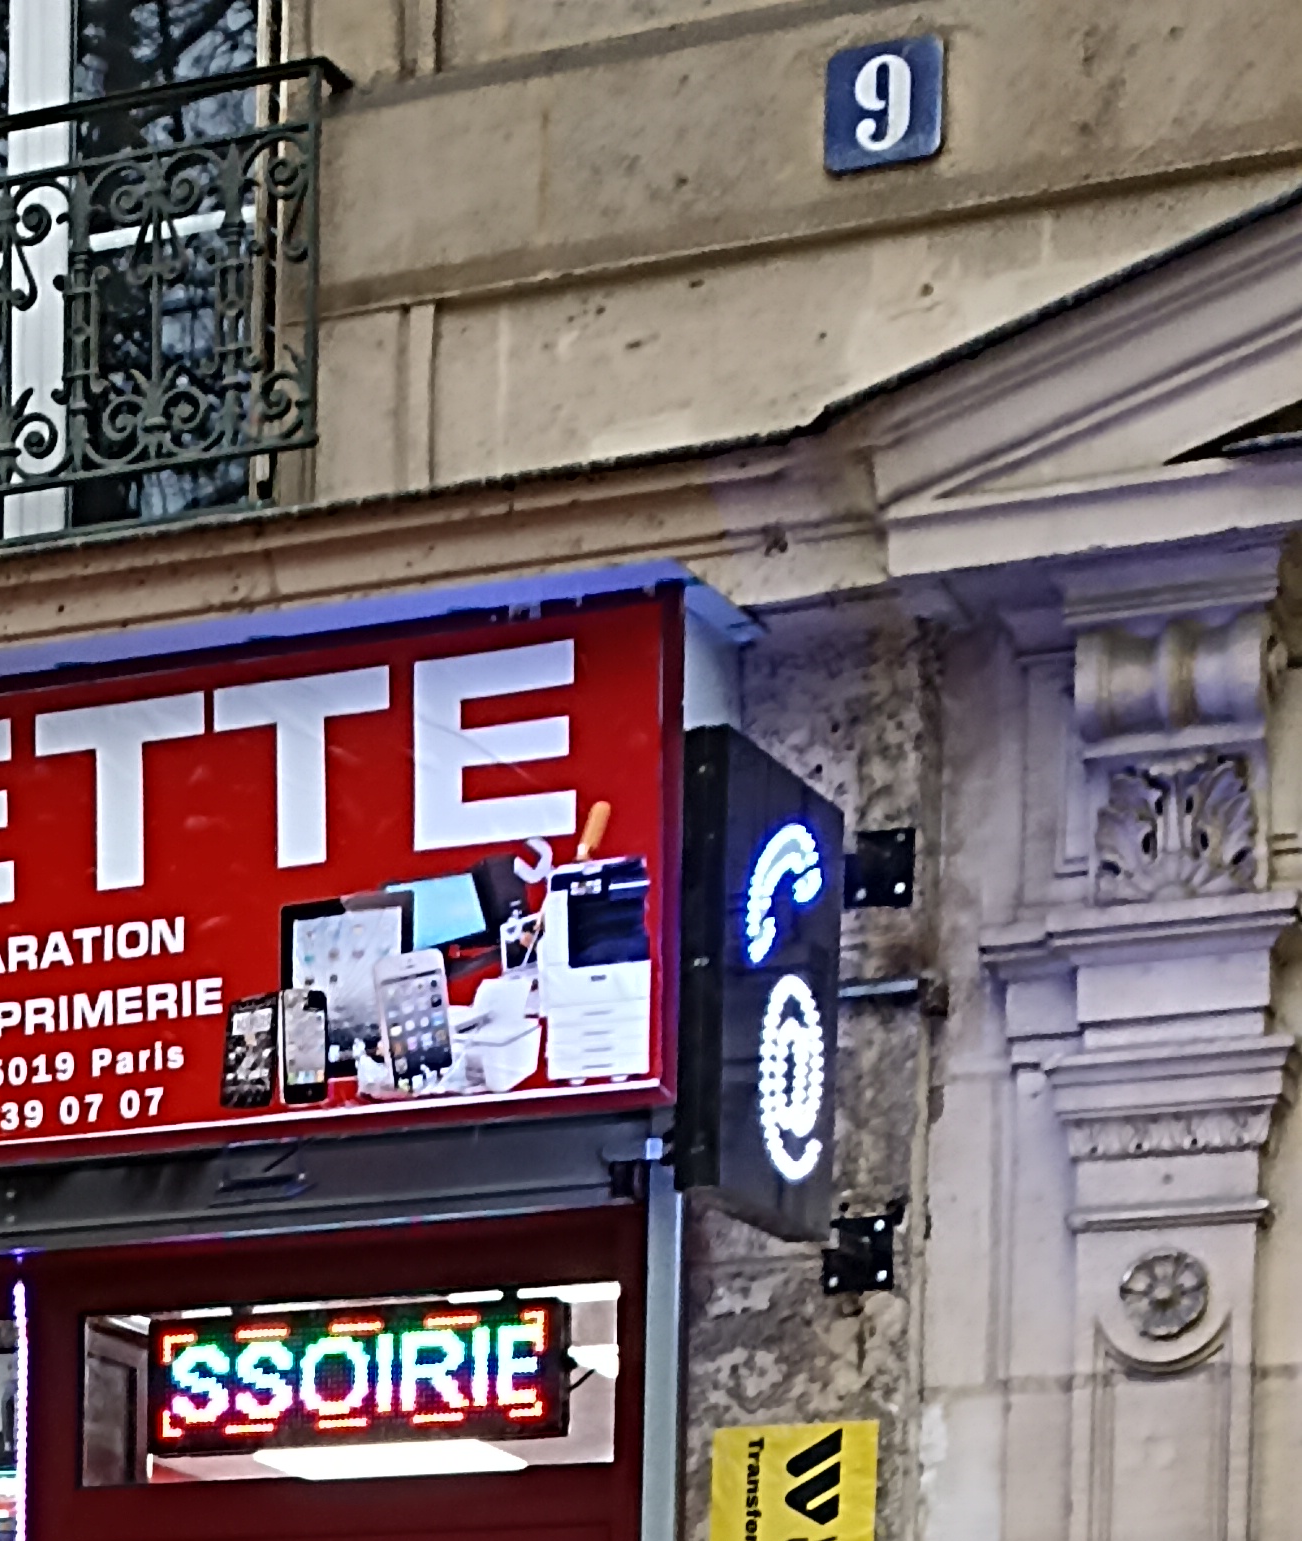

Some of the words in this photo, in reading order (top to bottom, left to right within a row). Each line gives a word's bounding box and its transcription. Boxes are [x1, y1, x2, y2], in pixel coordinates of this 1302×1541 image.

[854, 54, 911, 150] 9
[91, 1041, 185, 1078] Paris
[0, 1100, 44, 1130] 39
[59, 1093, 104, 1125] 07
[120, 1087, 164, 1119] 07
[171, 1323, 540, 1424] SSOIRIE
